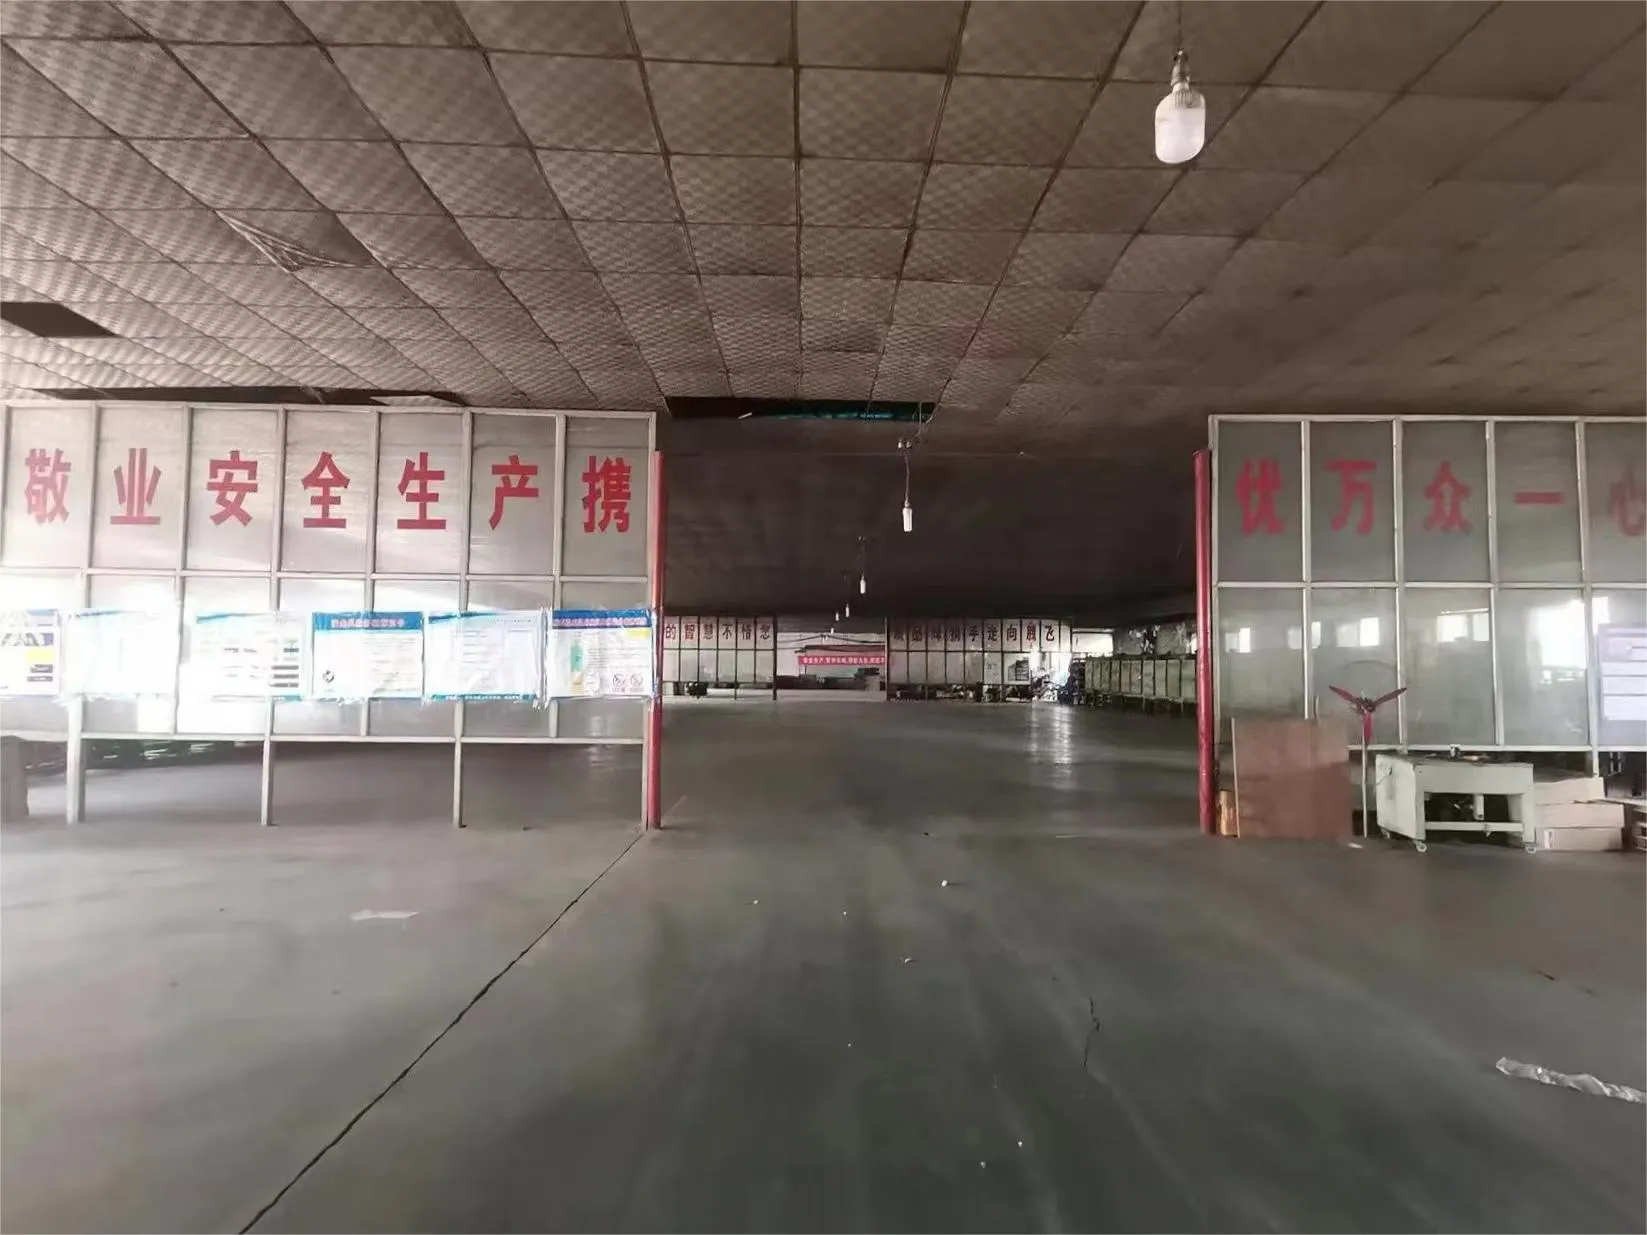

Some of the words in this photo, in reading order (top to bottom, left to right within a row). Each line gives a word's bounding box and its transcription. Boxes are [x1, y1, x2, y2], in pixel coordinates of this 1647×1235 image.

[24, 448, 634, 535] 敬业安全生产携
